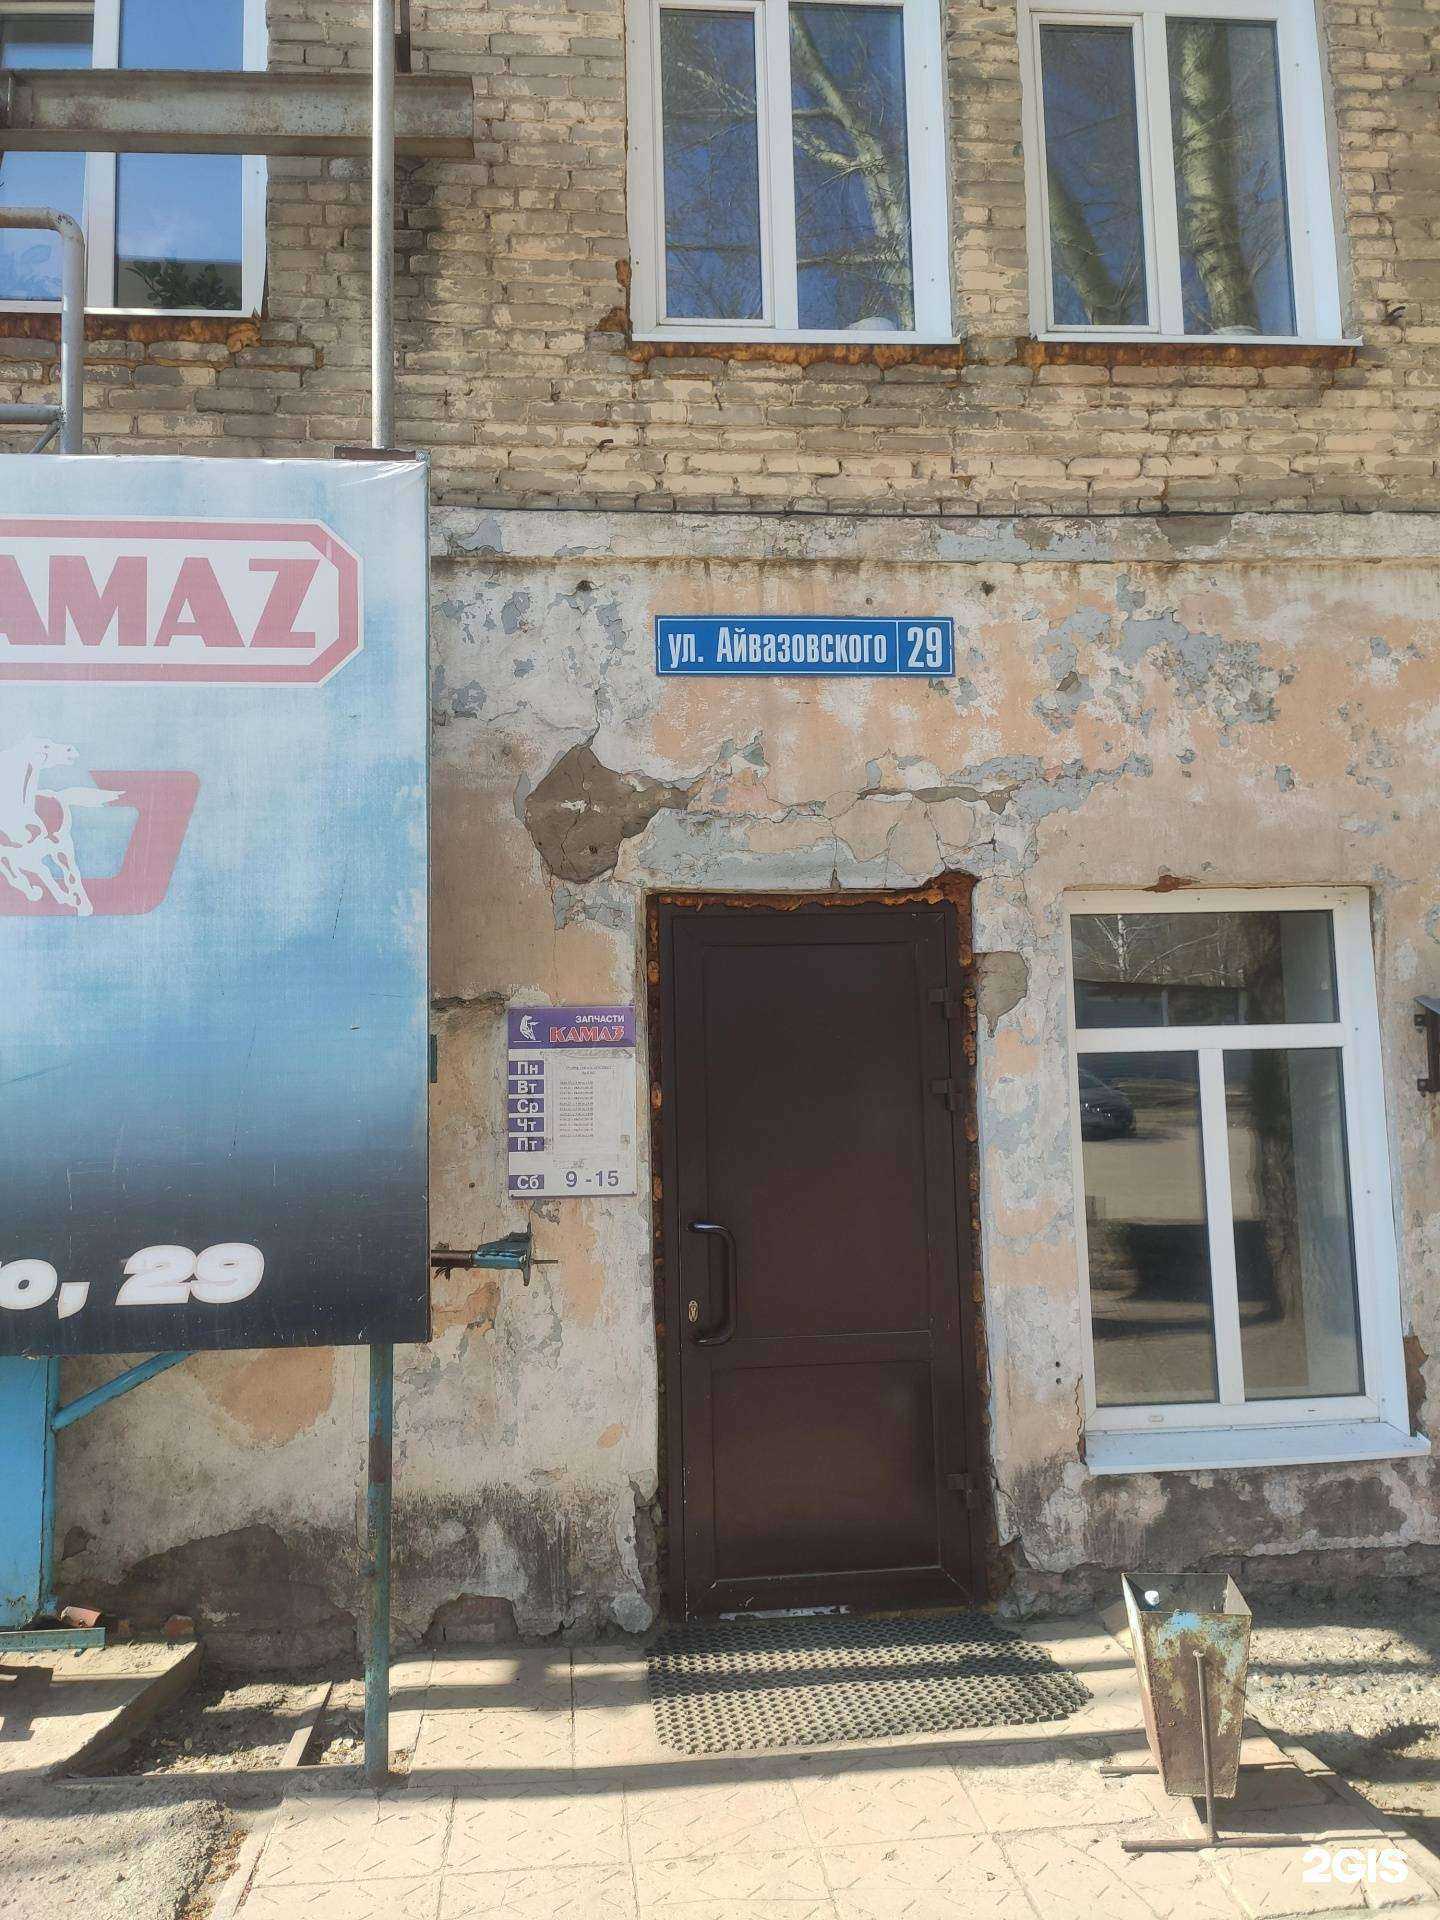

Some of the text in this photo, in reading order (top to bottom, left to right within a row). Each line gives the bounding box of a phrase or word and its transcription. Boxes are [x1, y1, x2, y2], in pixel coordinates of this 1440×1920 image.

[668, 627, 942, 668] ул. Айвазовского 29
[575, 1015, 624, 1023] ЗАПЧАСТИ
[517, 1062, 538, 1075] Пн
[518, 1081, 537, 1094] Вт
[517, 1099, 539, 1113] Ср
[517, 1118, 537, 1132] Чт
[518, 1137, 537, 1151] Пт
[517, 1175, 539, 1189] Сб
[115, 1242, 265, 1306] 29
